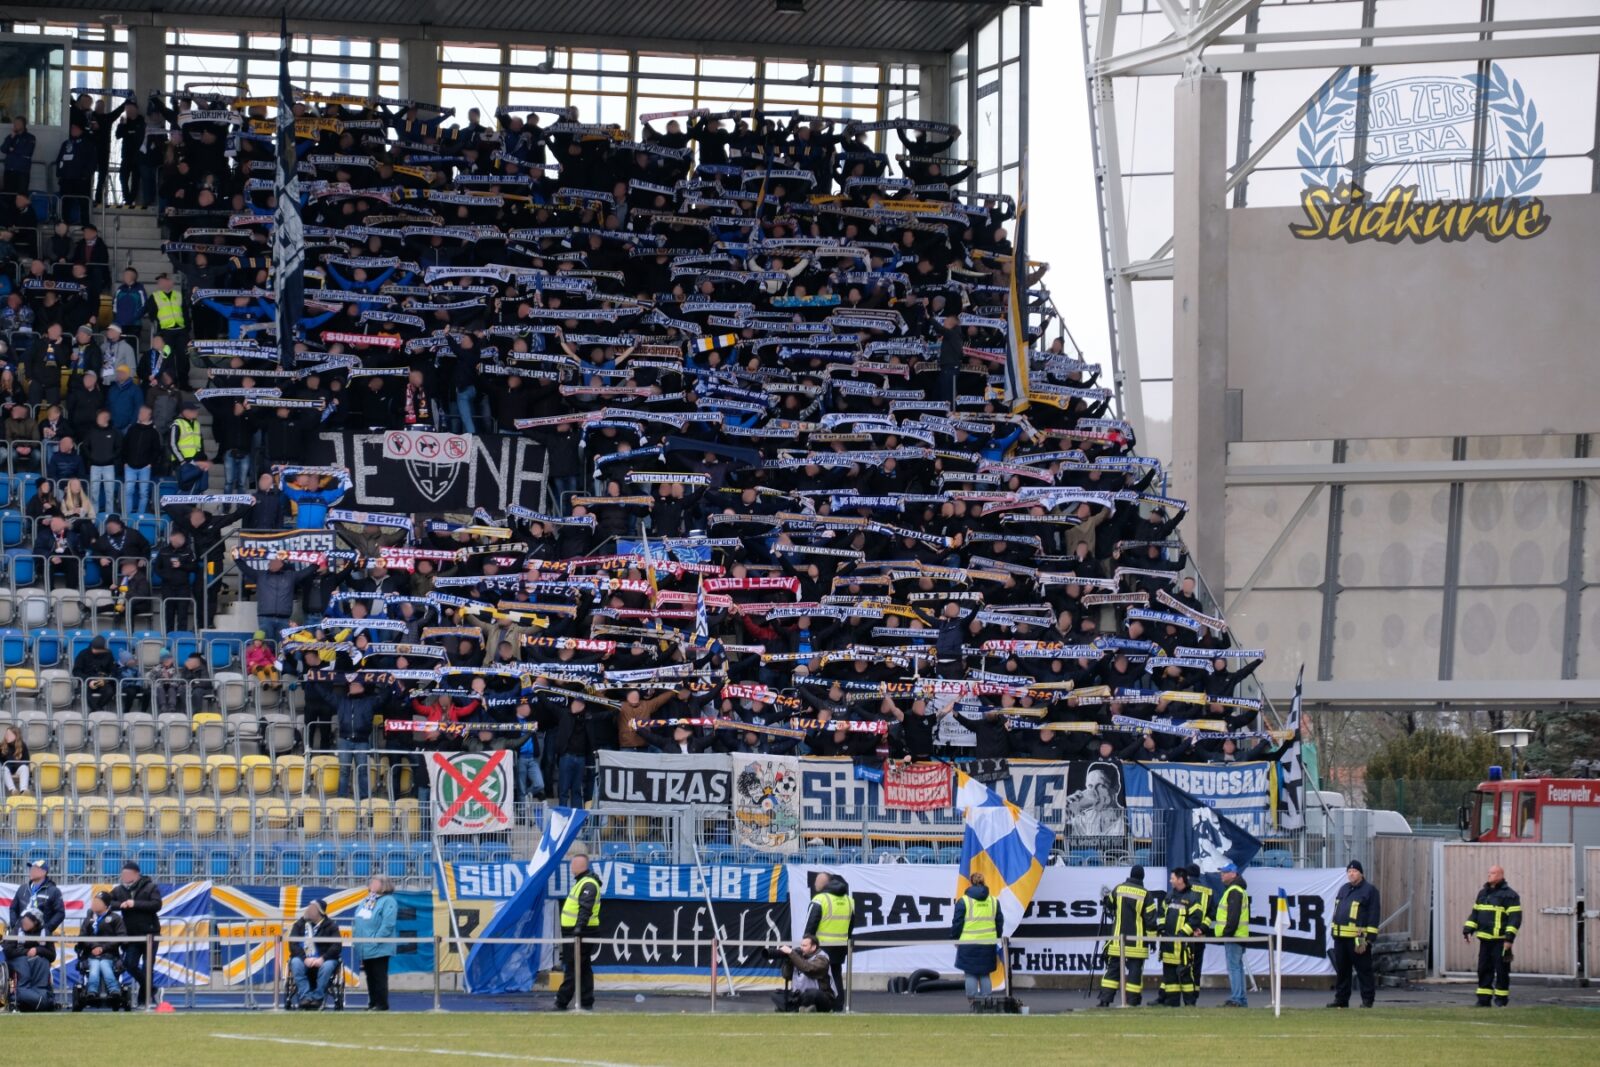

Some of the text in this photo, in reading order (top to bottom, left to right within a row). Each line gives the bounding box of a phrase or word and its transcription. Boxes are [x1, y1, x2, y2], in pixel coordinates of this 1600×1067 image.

[1367, 125, 1467, 160] JENA
[1291, 185, 1550, 241] Südkurve
[327, 509, 353, 520] LTE
[287, 551, 319, 563] RAS
[709, 578, 743, 589] ODIO
[578, 639, 606, 650] RAS
[849, 721, 878, 733] RAS
[604, 768, 728, 804] ULTRAS
[888, 785, 948, 802] MÜNCHEN
[1548, 784, 1591, 802] Feuerwehr
[459, 862, 766, 899] SÜDUVE BLEIBT
[590, 905, 781, 968] aalfeld
[1009, 946, 1108, 972] THÜRING
